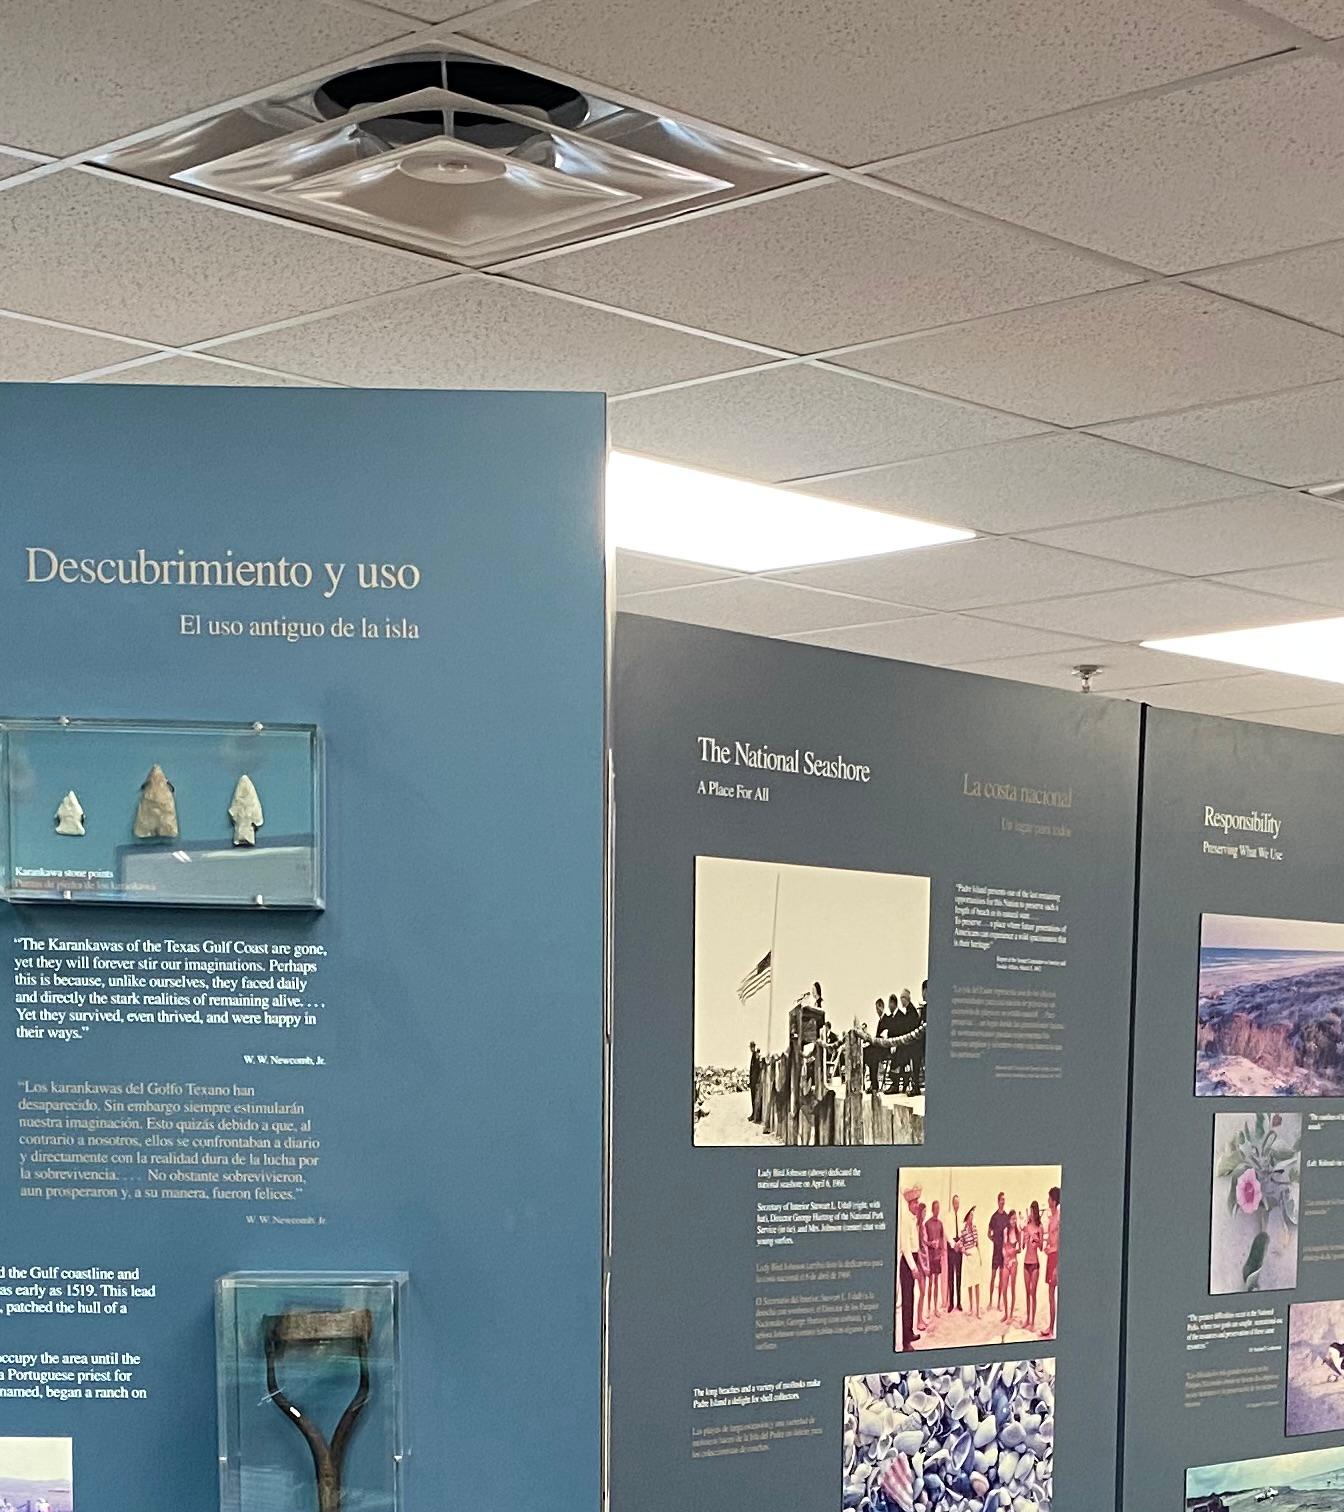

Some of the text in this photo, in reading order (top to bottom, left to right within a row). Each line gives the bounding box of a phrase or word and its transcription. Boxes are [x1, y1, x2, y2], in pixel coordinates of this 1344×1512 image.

[26, 548, 419, 597] Descubrimiento y uso
[181, 615, 419, 642] El uso antiguo de la isla
[698, 737, 870, 782] The National Seashore
[697, 781, 768, 801] A Place For All
[963, 773, 1072, 807] La costa nacional
[1205, 806, 1281, 839] Responsibility
[16, 867, 62, 877] Karankawa
[88, 869, 113, 880] points
[49, 938, 123, 951] Karankawas
[127, 940, 140, 952] of
[143, 940, 161, 952] the
[164, 940, 200, 952] Texas
[203, 941, 232, 953] Gulf
[234, 941, 268, 954] Coast
[272, 945, 291, 954] are
[294, 946, 327, 957] gone,
[9, 1267, 27, 1278] the
[30, 1267, 59, 1278] Gulf
[61, 1268, 114, 1280] coastline
[117, 1268, 139, 1280] and
